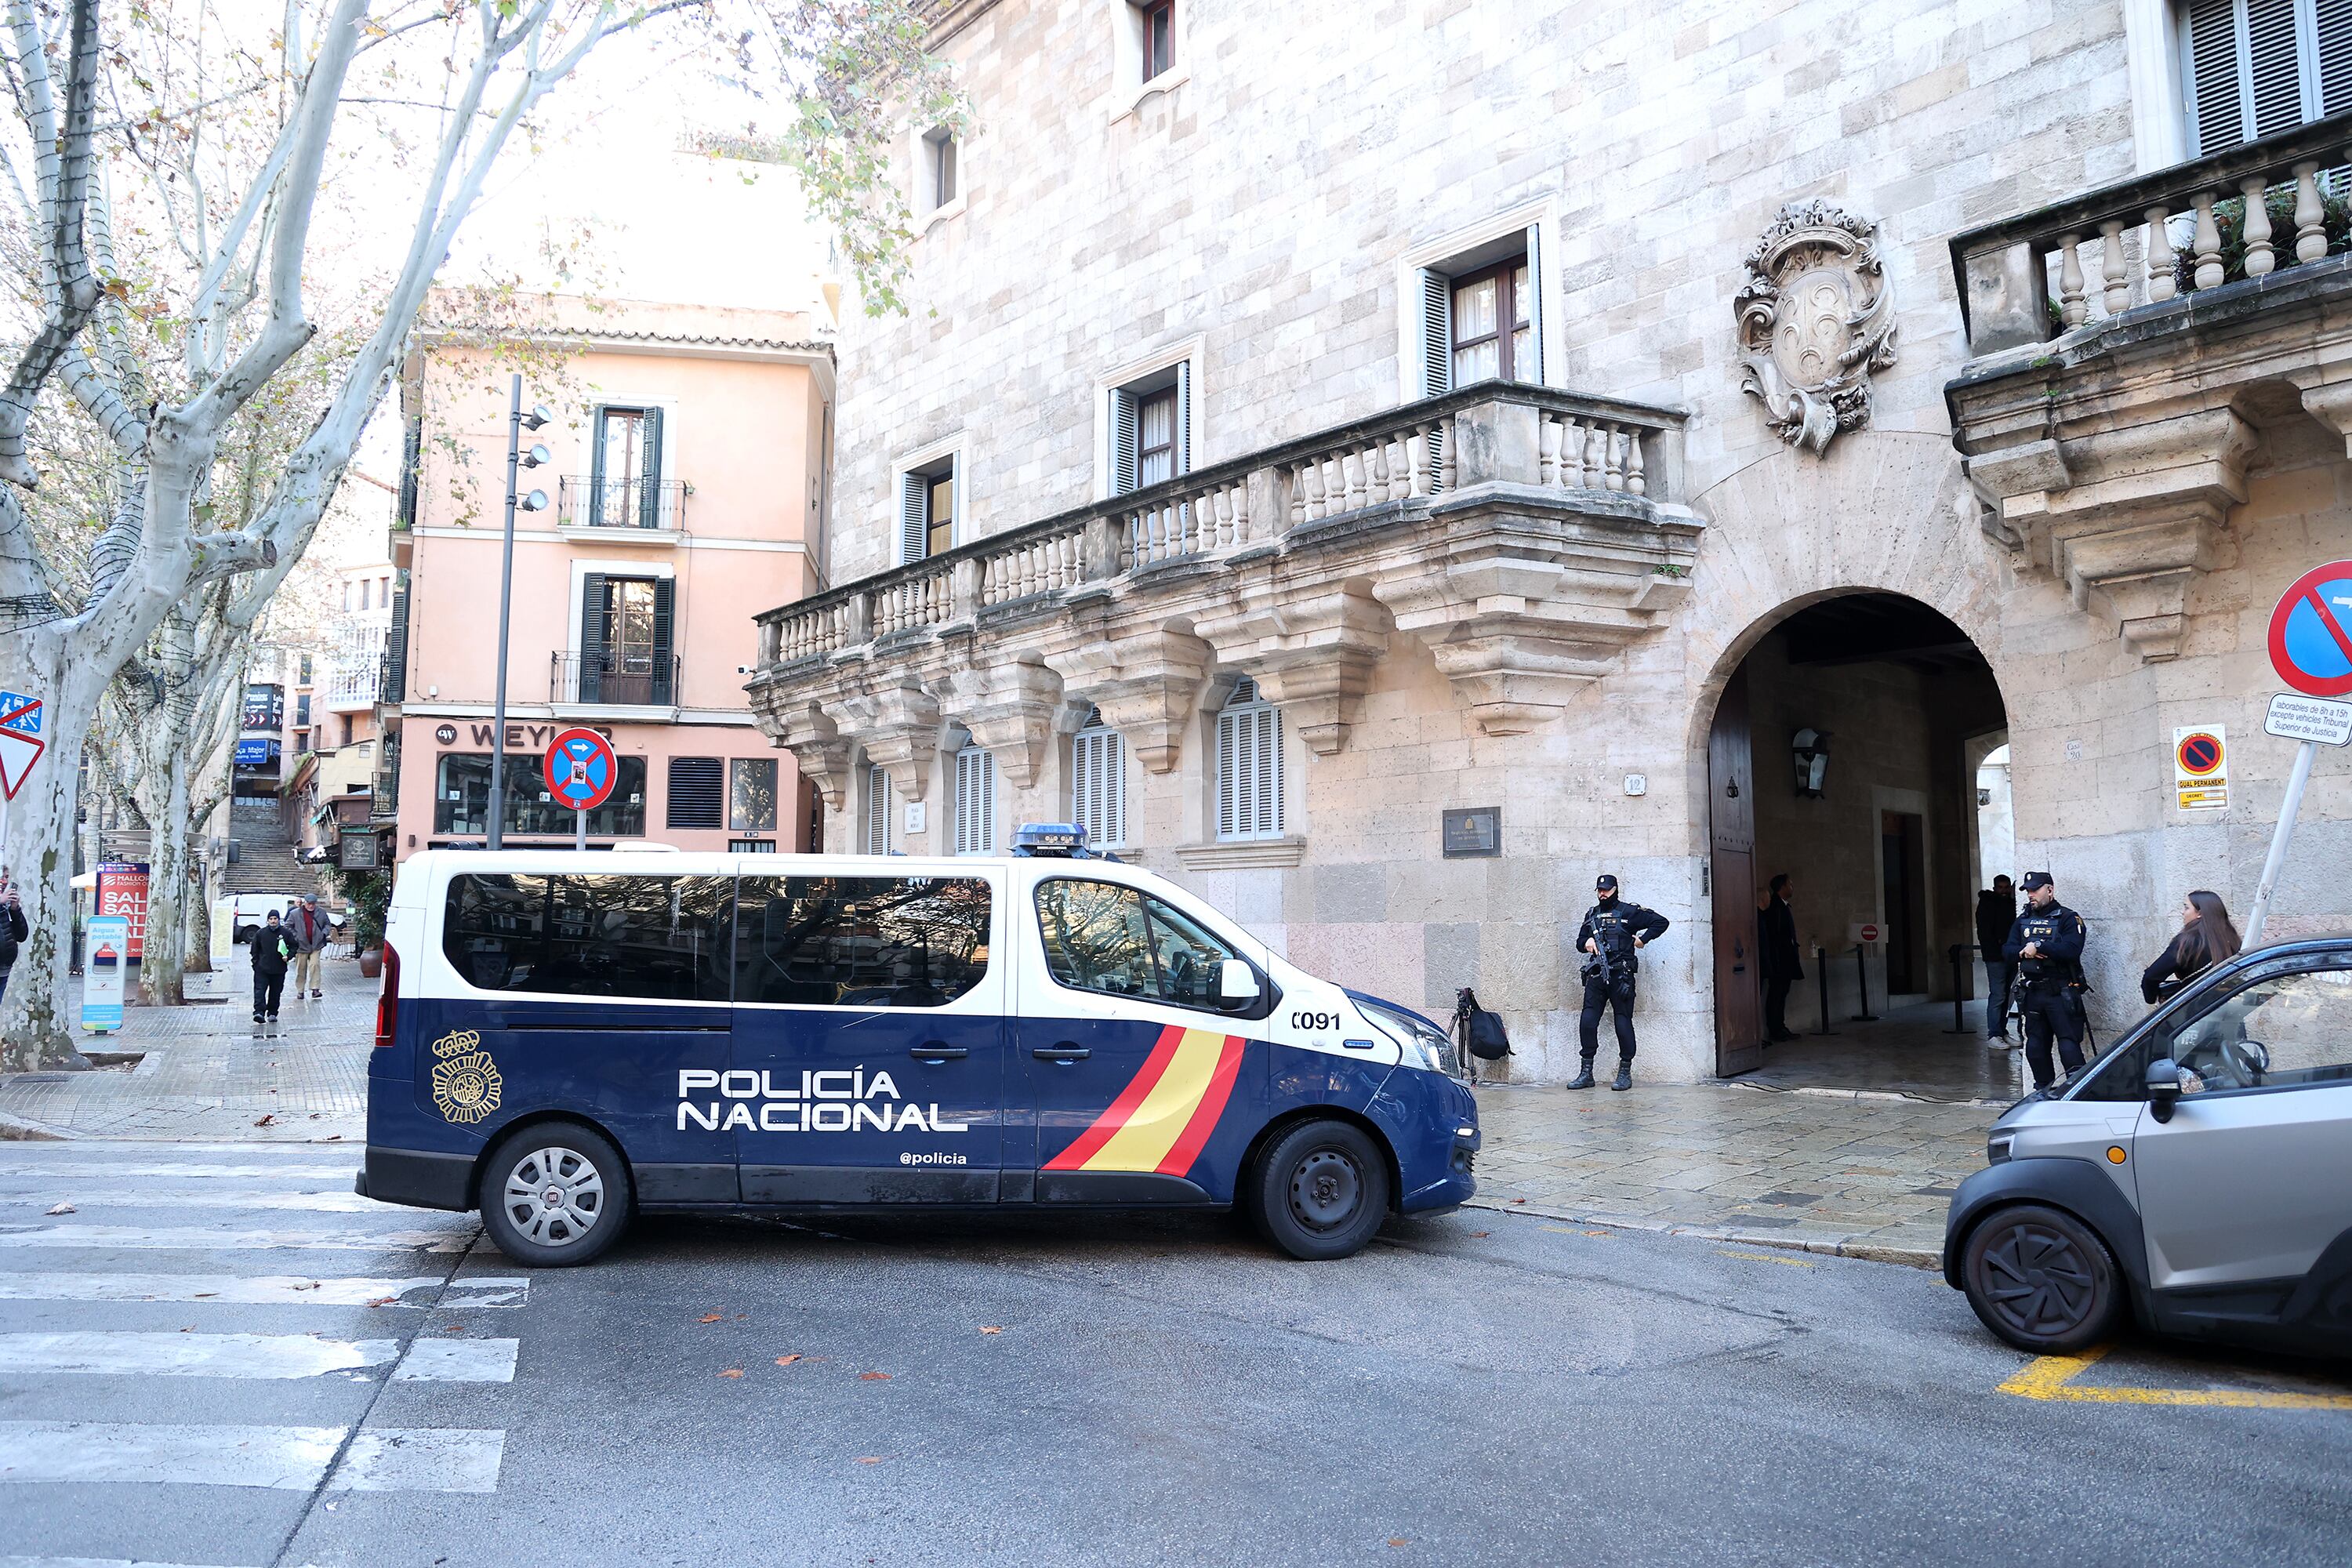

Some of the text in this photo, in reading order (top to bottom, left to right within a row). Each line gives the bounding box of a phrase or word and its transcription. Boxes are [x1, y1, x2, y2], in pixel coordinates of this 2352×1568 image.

[2276, 701, 2309, 713] laborables
[2310, 706, 2319, 714] de
[2319, 706, 2328, 715] 8h
[2336, 709, 2348, 718] 15h
[2270, 710, 2350, 728] excepte vehicles Tribunal
[2274, 720, 2301, 731] Superior
[1629, 779, 1640, 790] 12
[2194, 779, 2224, 787] PERMANENT
[104, 891, 146, 903] SAL
[103, 903, 146, 915] SAL
[1301, 1011, 1340, 1030] 091
[456, 1068, 482, 1076] NACIONAL
[677, 1064, 902, 1099] POLICÍA
[677, 1101, 969, 1132] NACIONAL
[900, 1152, 967, 1165] @policia
